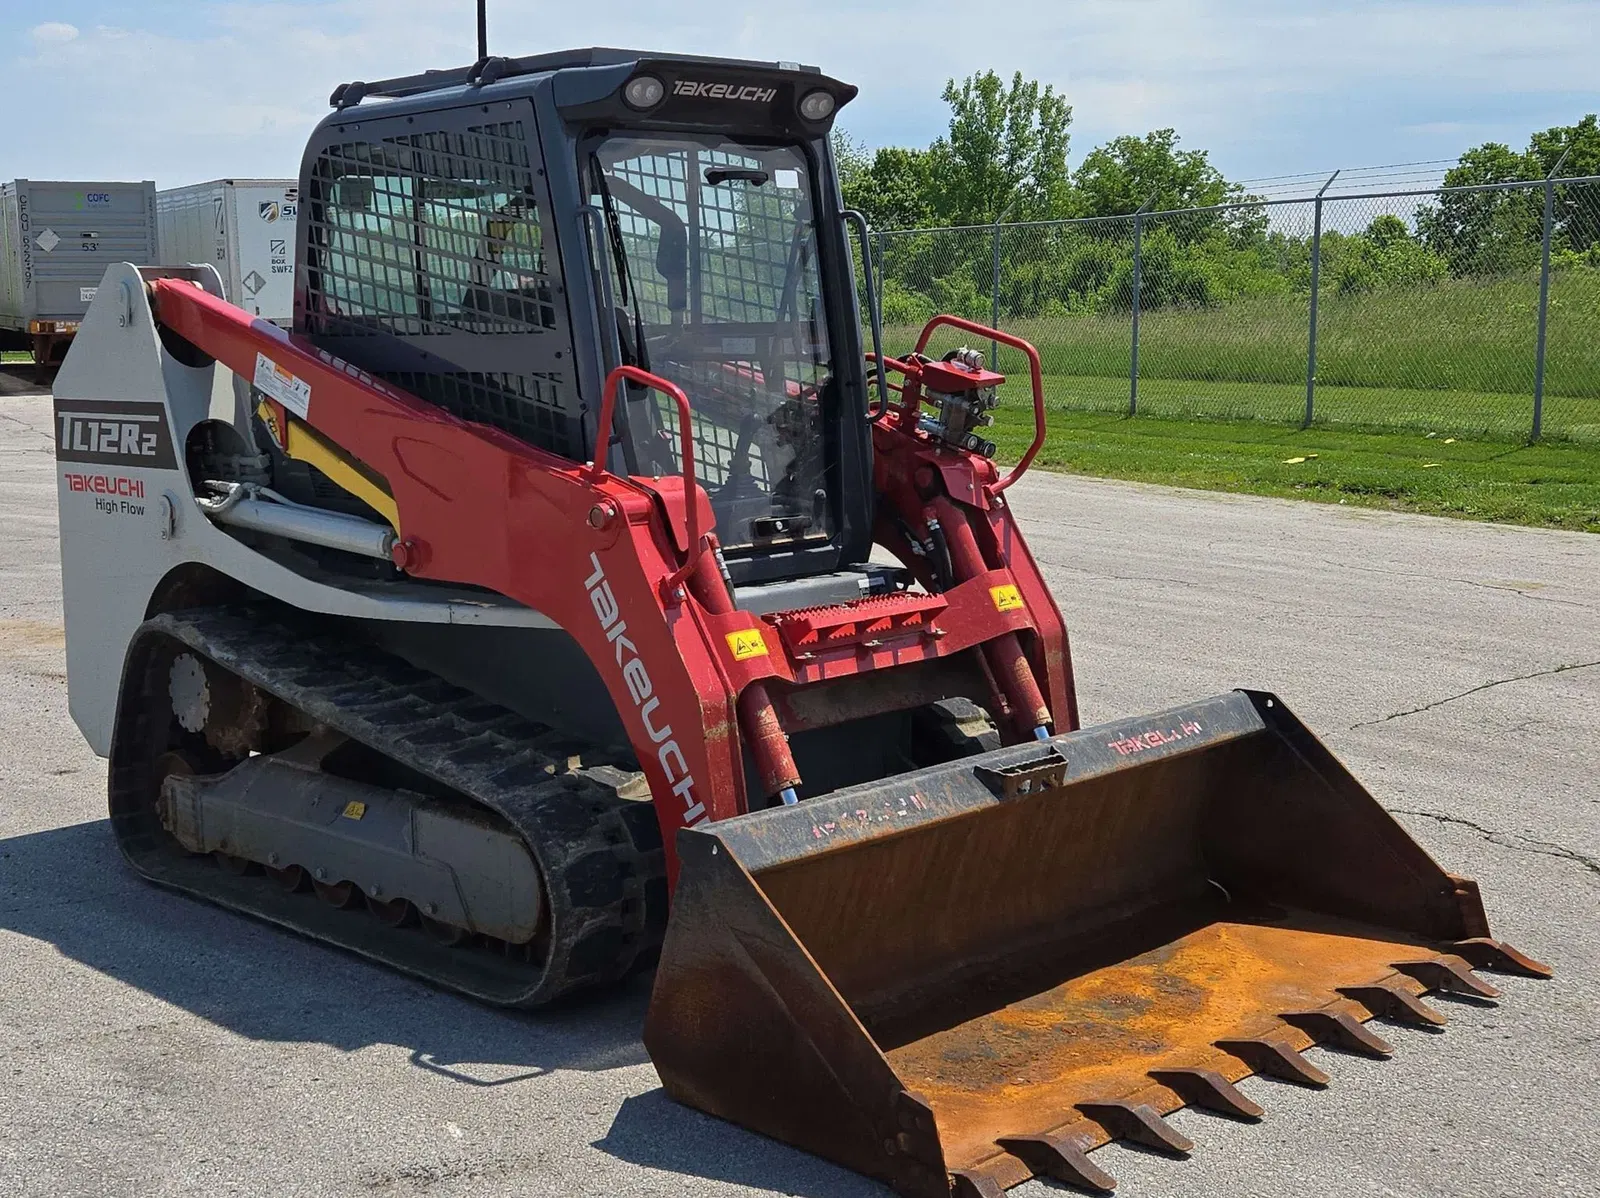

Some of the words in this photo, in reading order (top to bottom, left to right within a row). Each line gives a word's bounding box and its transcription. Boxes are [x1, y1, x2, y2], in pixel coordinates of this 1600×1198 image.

[673, 80, 777, 102] TAKEUCHI
[19, 194, 29, 231] CFQU
[271, 265, 293, 274] SWFZ
[58, 411, 159, 456] TL12R2
[64, 473, 144, 498] TAKEUCHI
[95, 498, 118, 515] High
[120, 501, 145, 516] Flow
